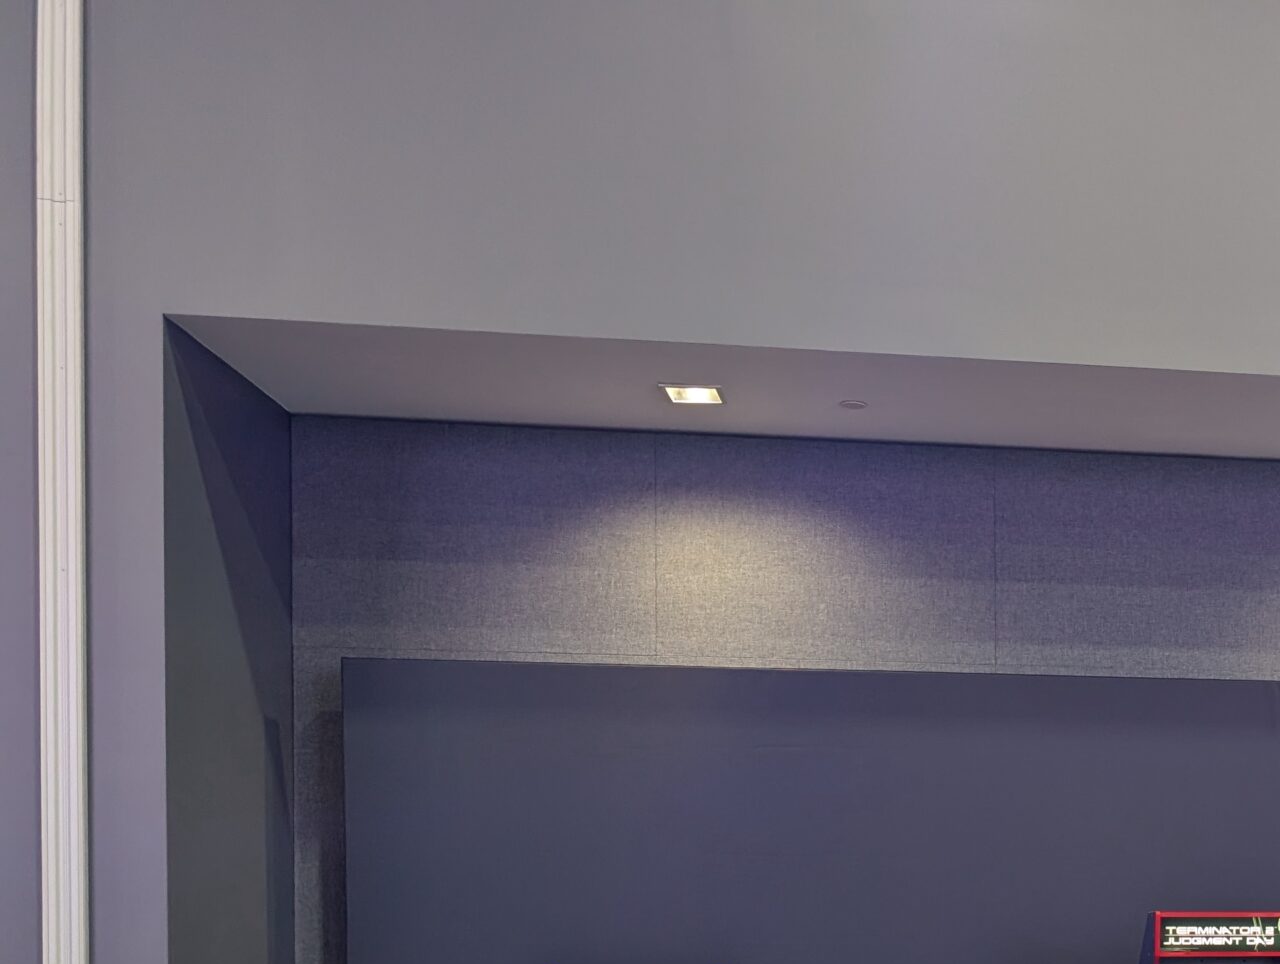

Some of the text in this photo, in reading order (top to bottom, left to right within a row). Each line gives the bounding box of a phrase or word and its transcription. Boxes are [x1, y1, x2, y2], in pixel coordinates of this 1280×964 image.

[1165, 926, 1275, 935] TERMINATOR 2
[1163, 937, 1275, 946] JUDGMENT DAY
